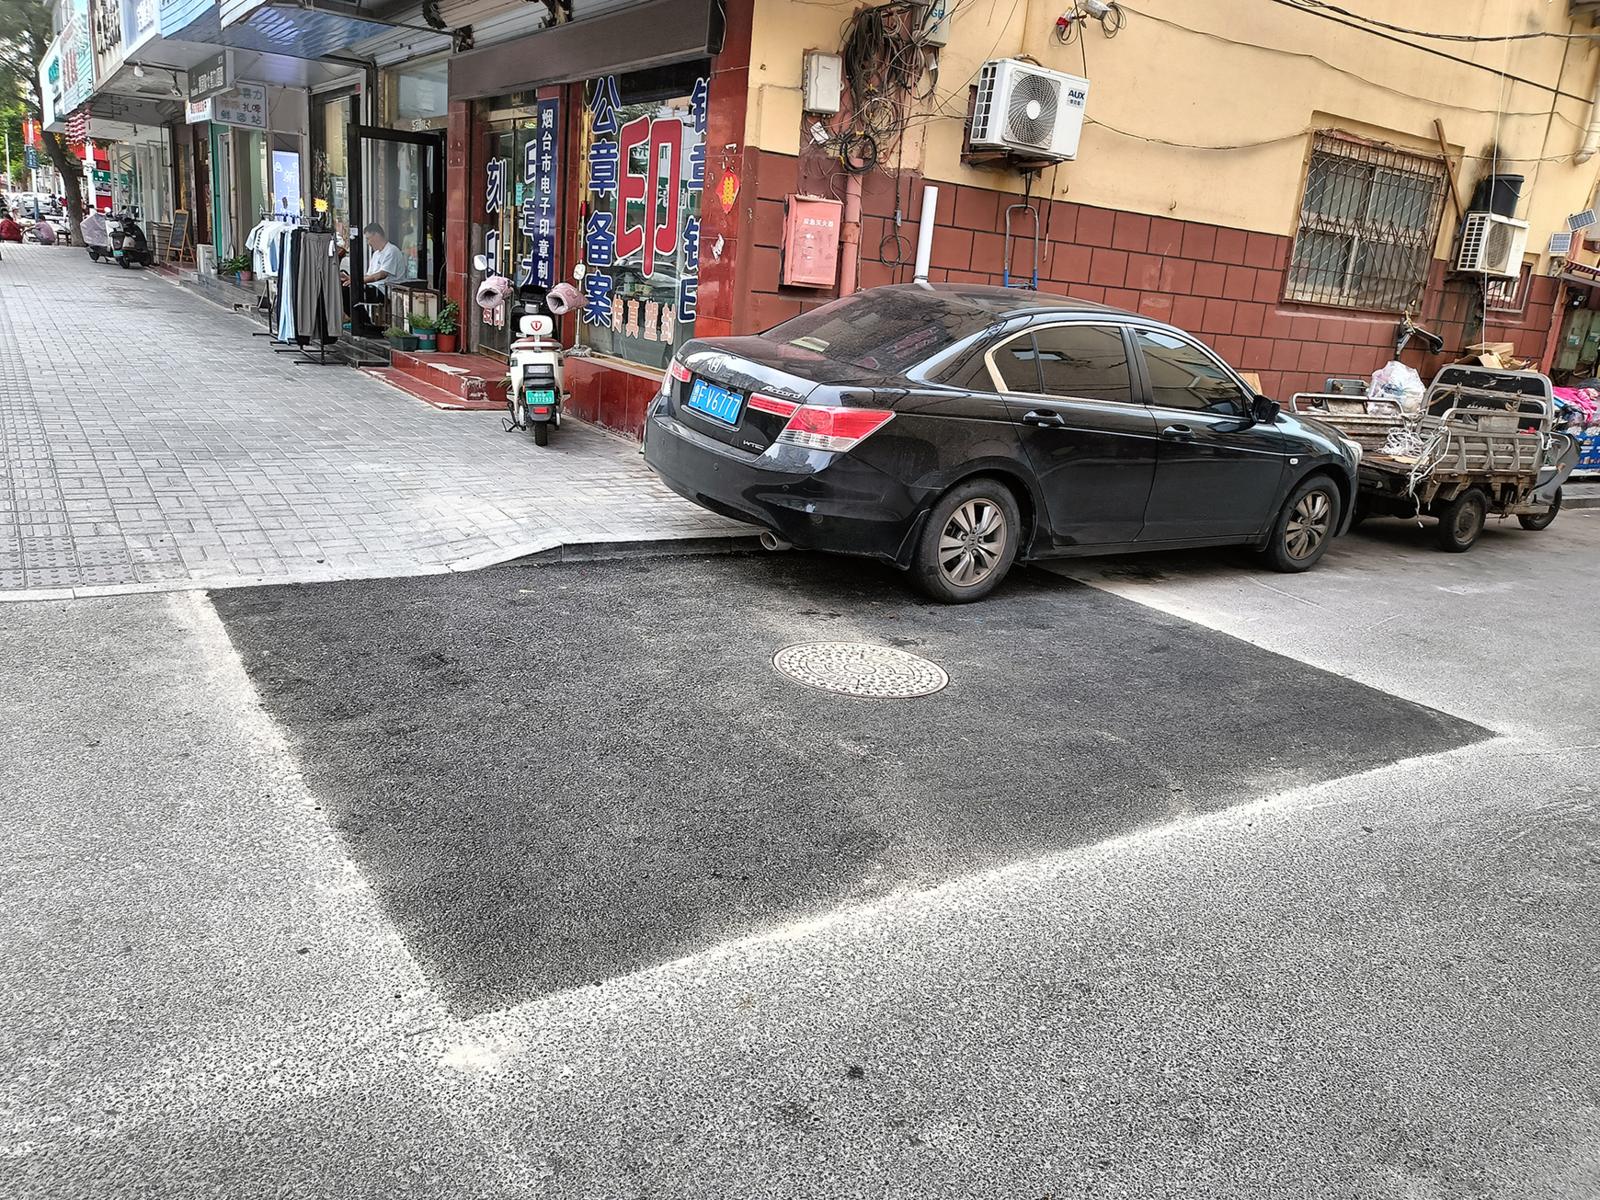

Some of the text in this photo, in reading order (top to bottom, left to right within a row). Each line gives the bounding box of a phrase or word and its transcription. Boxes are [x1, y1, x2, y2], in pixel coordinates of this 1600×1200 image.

[1068, 89, 1085, 100] AUX
[583, 75, 621, 327] 公章备案
[615, 114, 684, 279] 印
[761, 385, 803, 399] Accord
